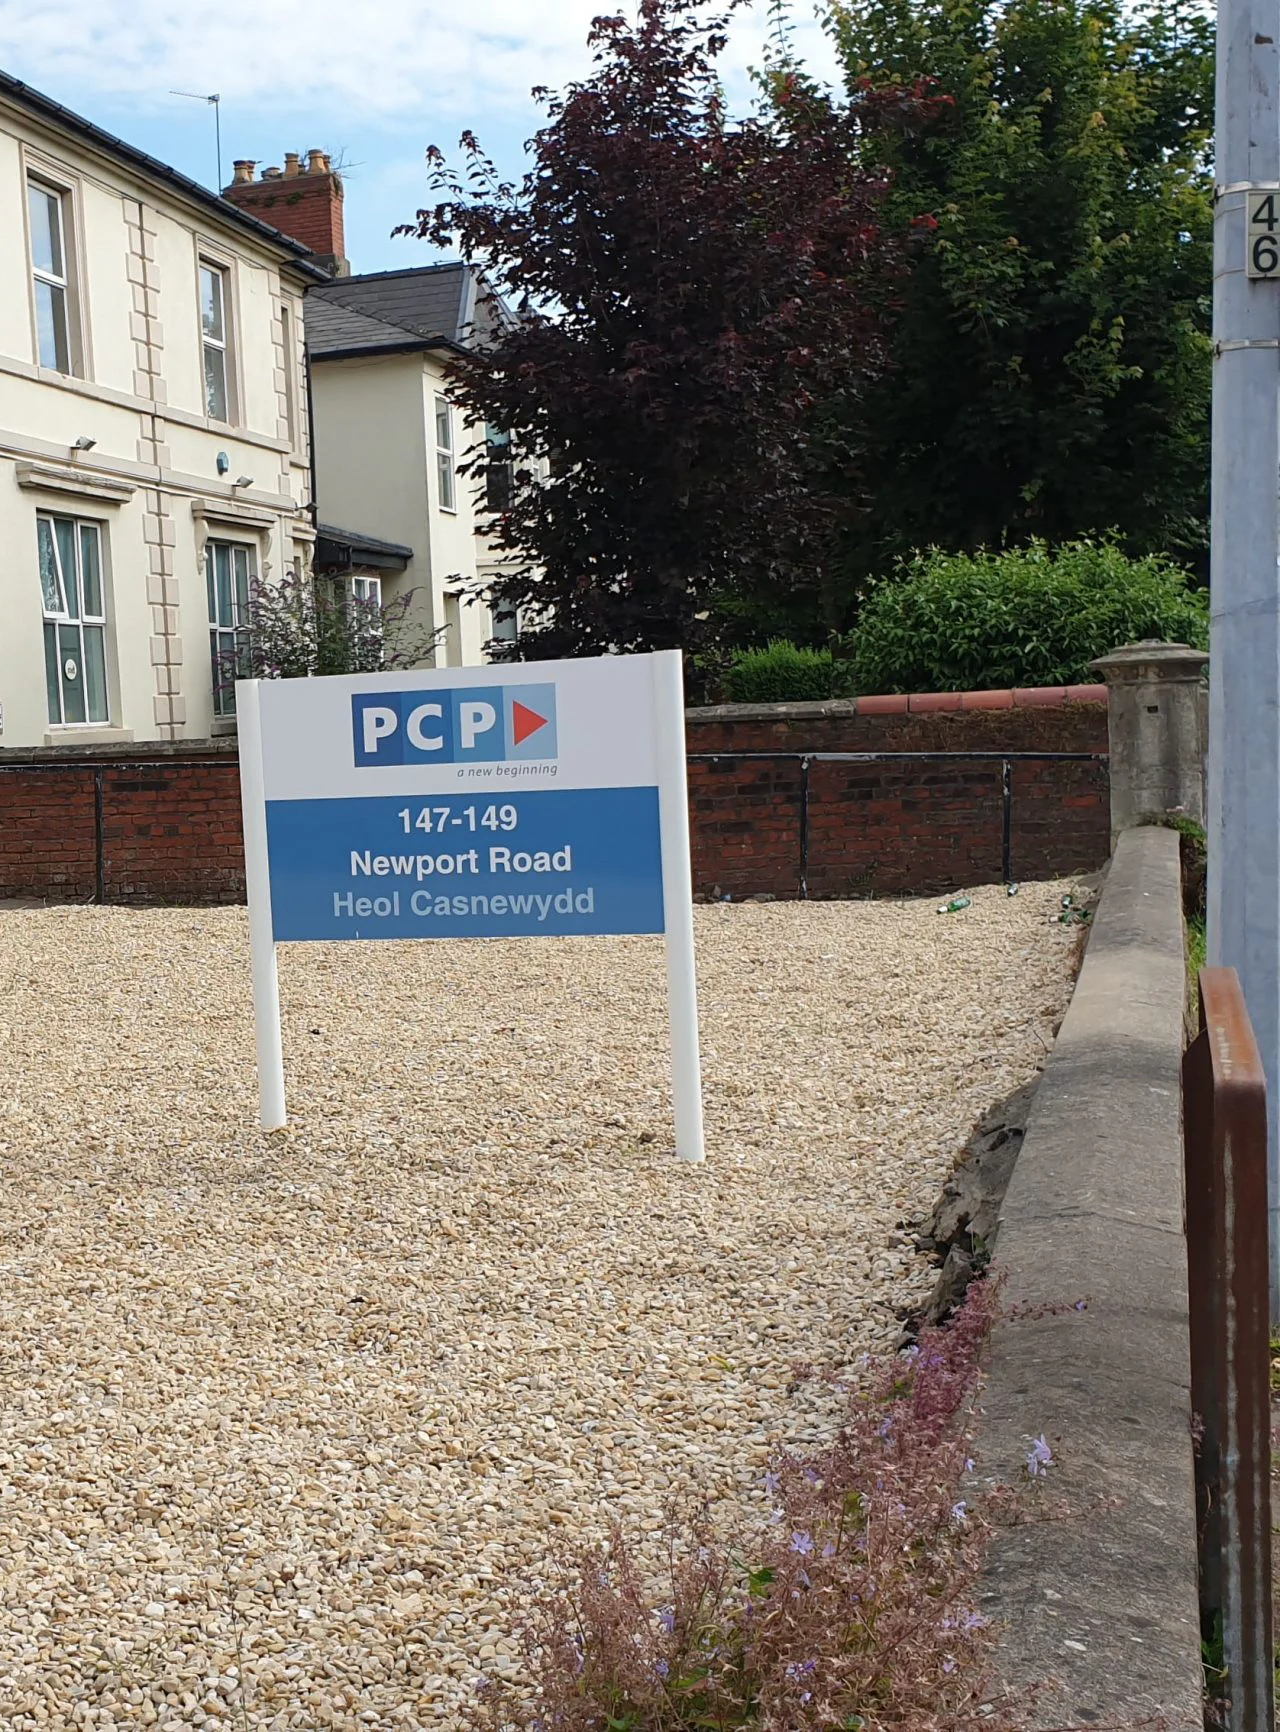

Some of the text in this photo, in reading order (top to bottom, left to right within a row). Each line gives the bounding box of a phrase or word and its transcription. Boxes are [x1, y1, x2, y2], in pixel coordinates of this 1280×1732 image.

[362, 701, 497, 753] PCP
[457, 763, 558, 778] a new beginning
[398, 804, 519, 834] 147-149
[350, 845, 573, 881] Newport Road
[333, 886, 595, 921] Heol Casnewydd
